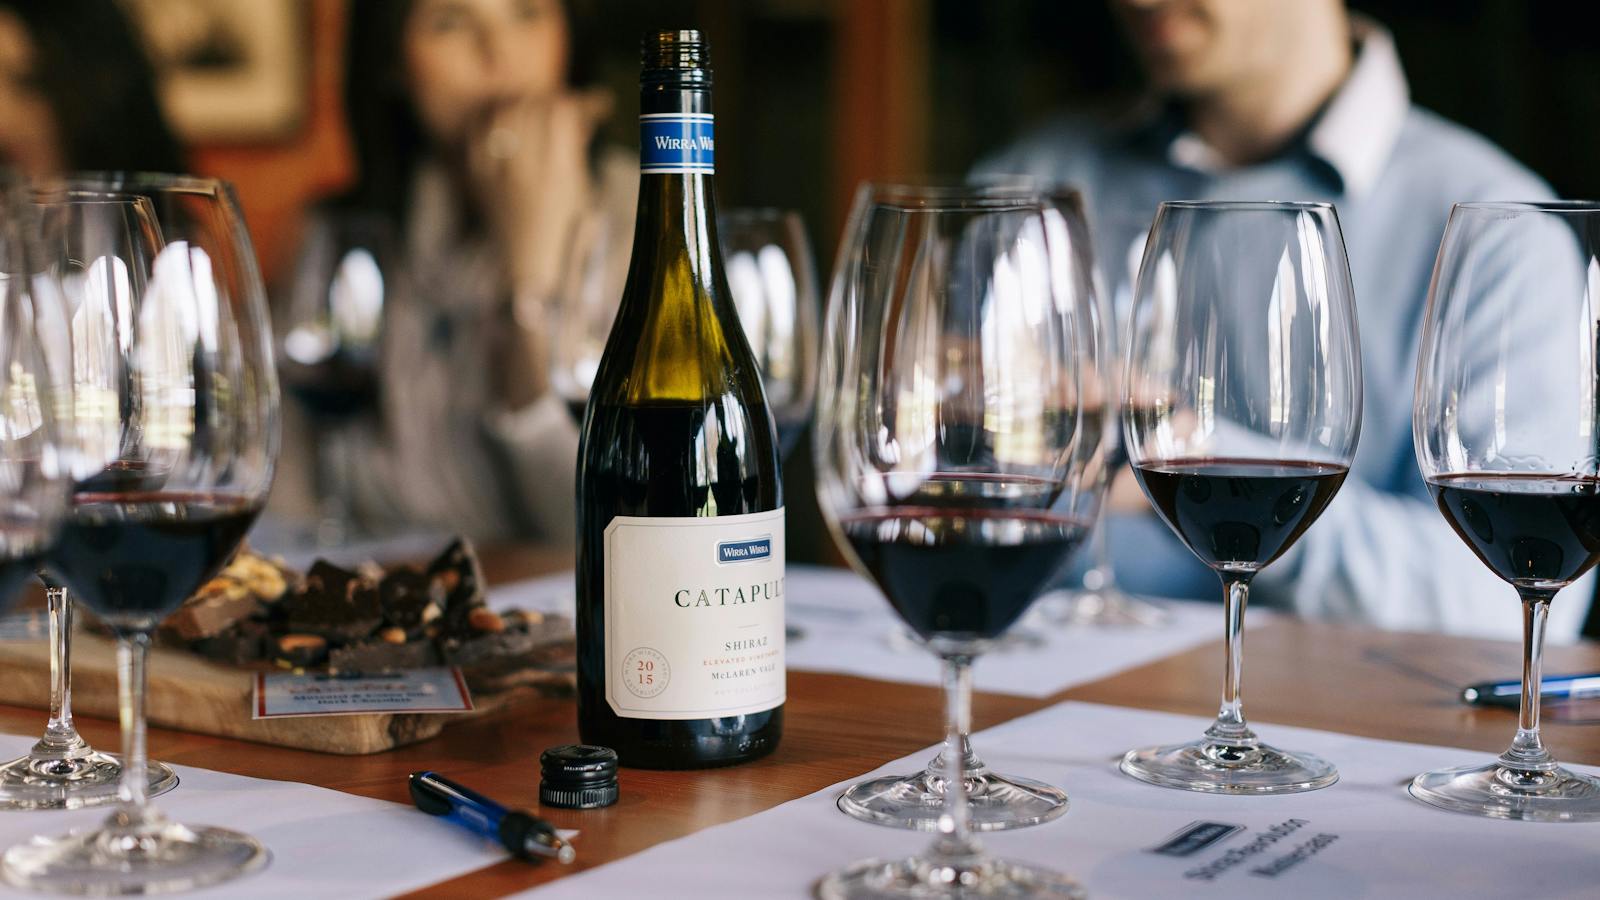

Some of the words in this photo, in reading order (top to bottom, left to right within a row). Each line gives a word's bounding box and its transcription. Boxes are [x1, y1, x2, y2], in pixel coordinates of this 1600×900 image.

[655, 136, 697, 150] WIRRA
[723, 547, 749, 558] WIRRA
[749, 544, 769, 555] WIRRA
[725, 636, 768, 652] SHIRAZ
[637, 660, 653, 671] 20
[703, 656, 746, 666] ELEVATED
[712, 668, 757, 680] McLAREN
[759, 663, 776, 673] VALE
[640, 674, 653, 684] 15
